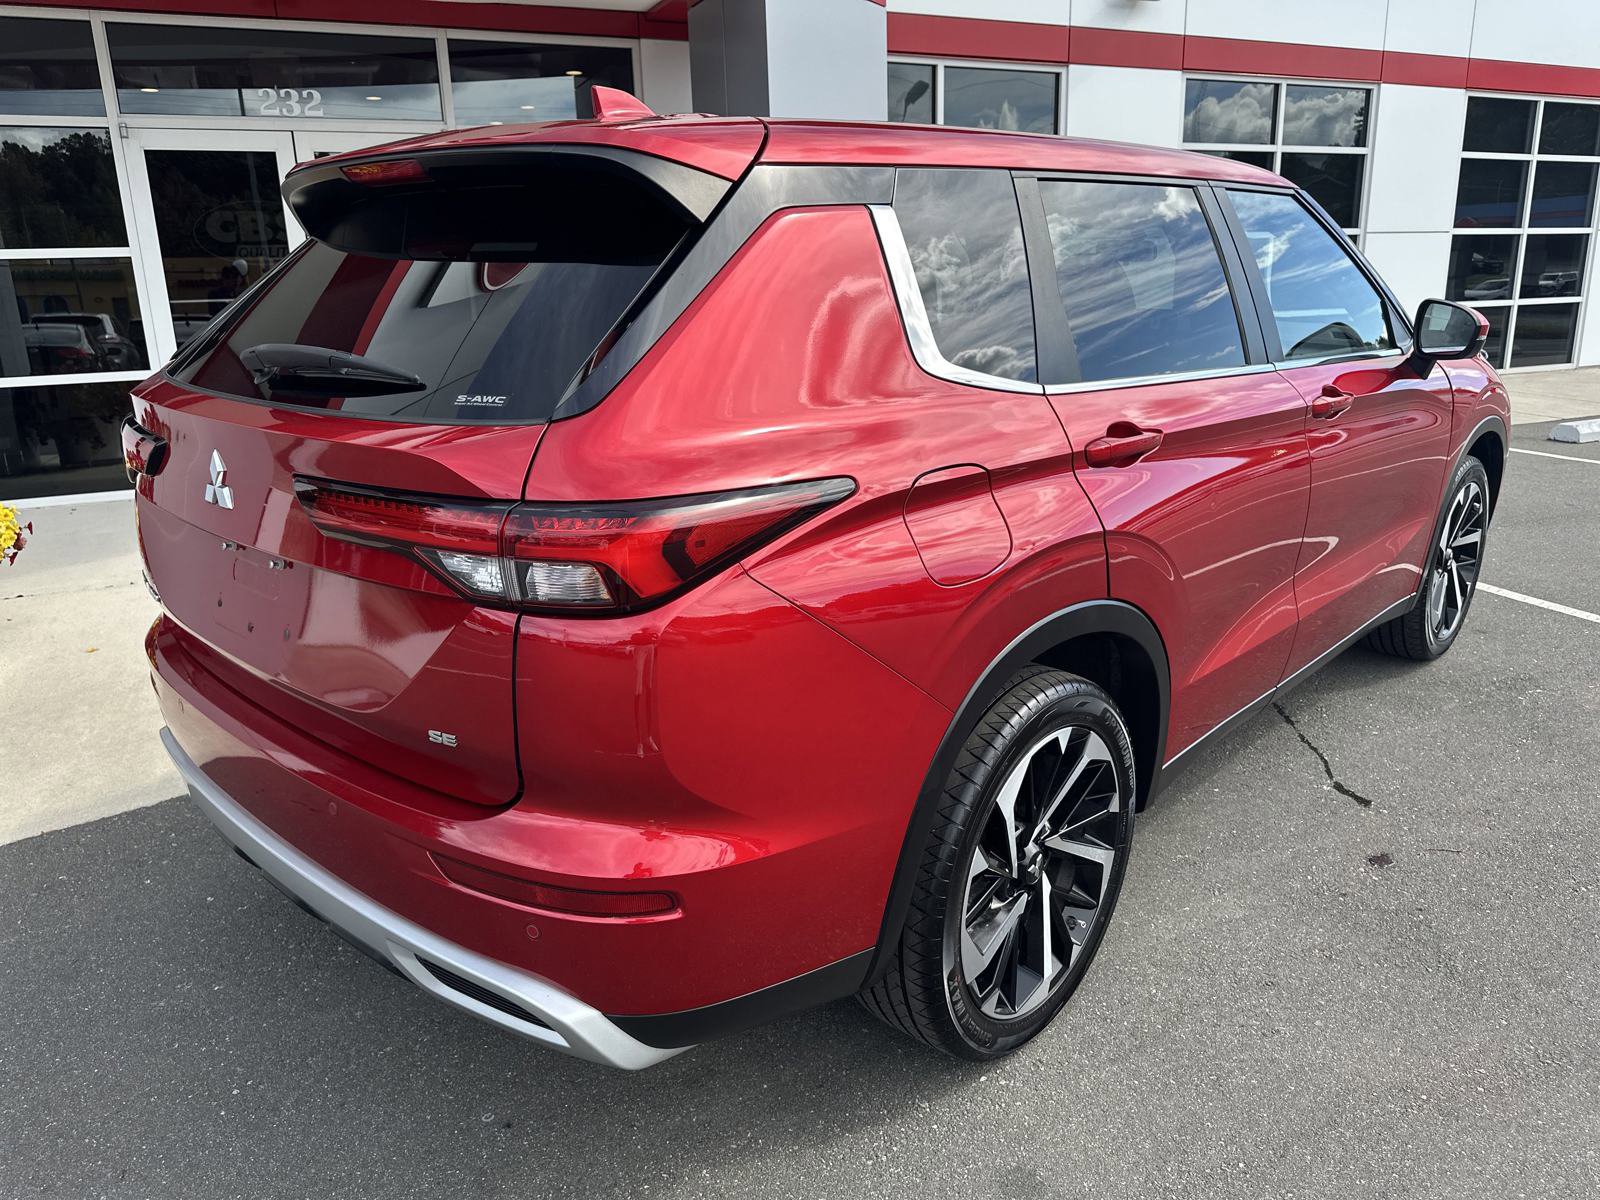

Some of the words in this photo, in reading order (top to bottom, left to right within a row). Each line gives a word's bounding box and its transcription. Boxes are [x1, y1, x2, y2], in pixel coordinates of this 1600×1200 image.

[258, 88, 324, 117] 232
[239, 246, 288, 257] QUALIT
[456, 394, 507, 403] S-AWC
[428, 730, 458, 748] SE
